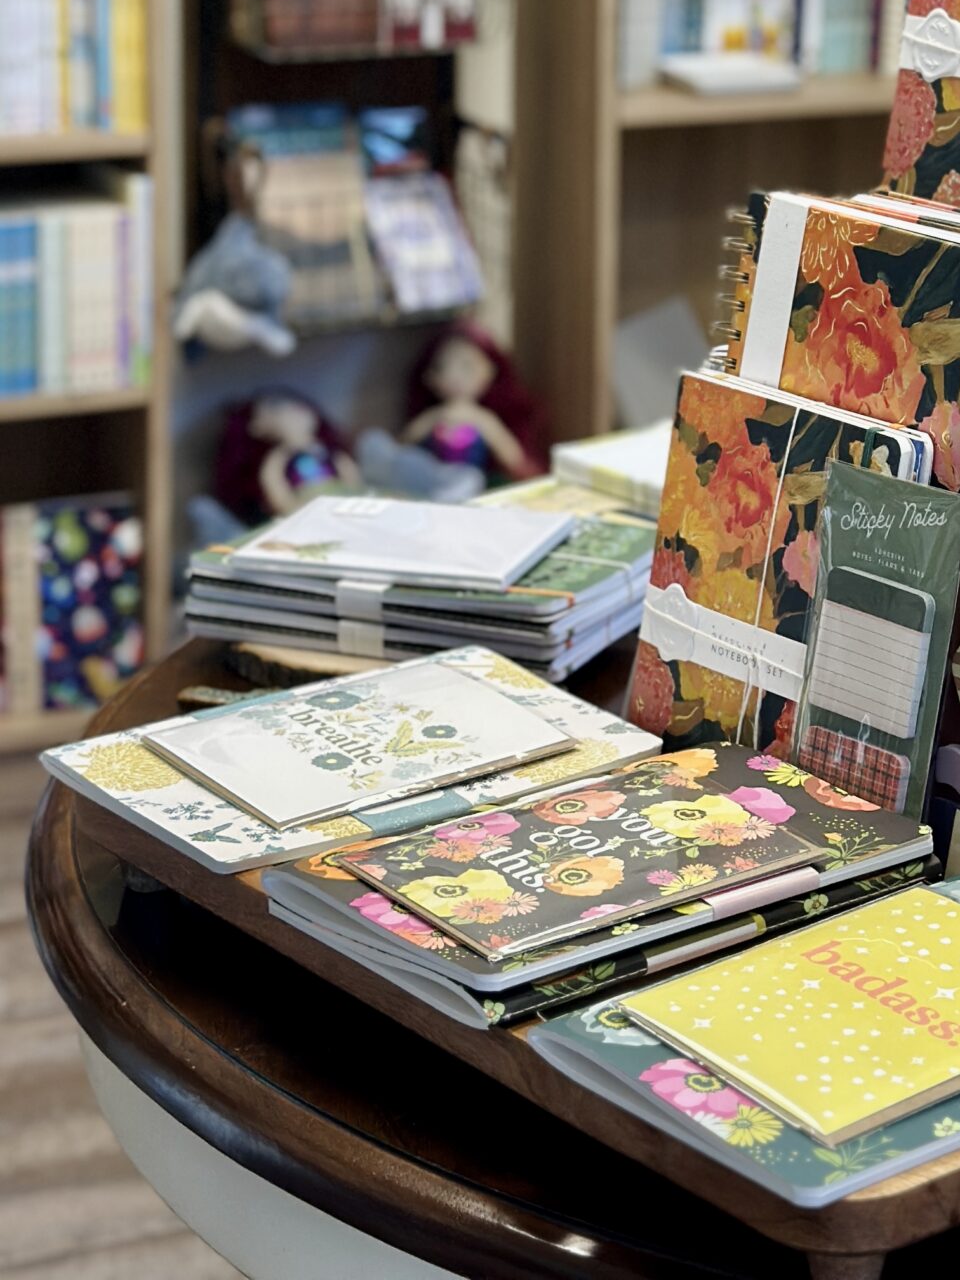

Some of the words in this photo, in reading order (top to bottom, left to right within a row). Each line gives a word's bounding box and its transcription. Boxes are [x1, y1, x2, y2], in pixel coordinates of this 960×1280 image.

[840, 502, 896, 540] Sticky
[898, 500, 948, 529] Notes
[766, 663, 784, 678] SET
[289, 708, 383, 766] breathe
[529, 824, 618, 858] got
[588, 806, 677, 847] you
[479, 846, 554, 893] this.
